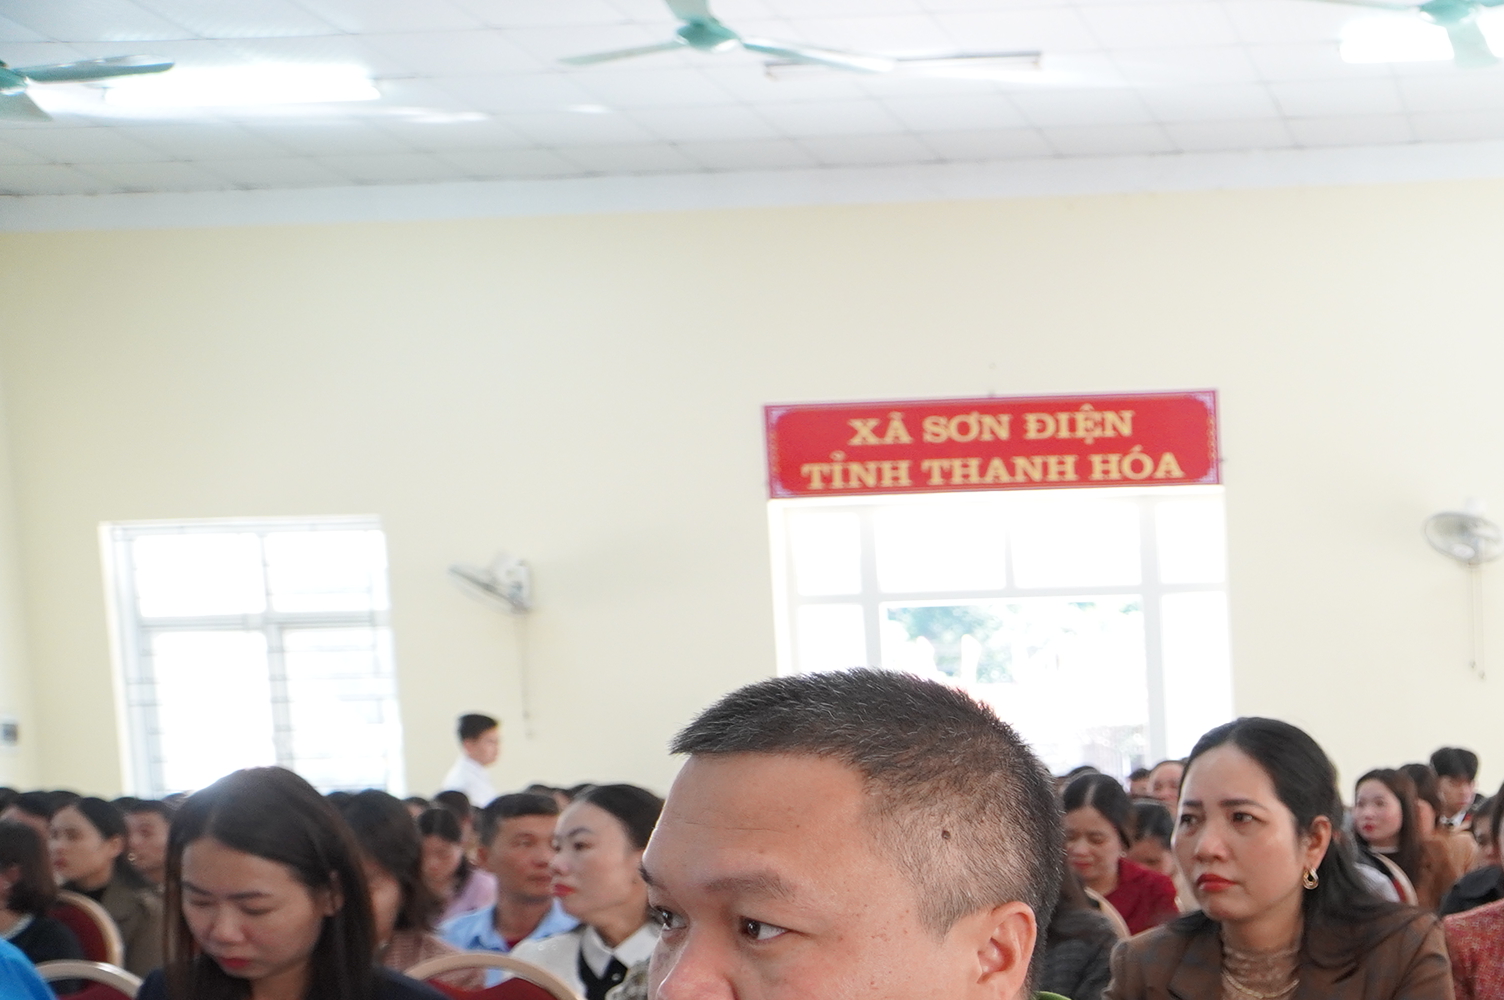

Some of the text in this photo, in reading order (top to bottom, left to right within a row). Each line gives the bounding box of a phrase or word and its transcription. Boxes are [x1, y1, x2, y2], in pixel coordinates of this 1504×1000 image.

[846, 403, 1135, 446] XÃ SƠN ĐIỆN
[800, 445, 1185, 490] TỈNH THANH HÓA
